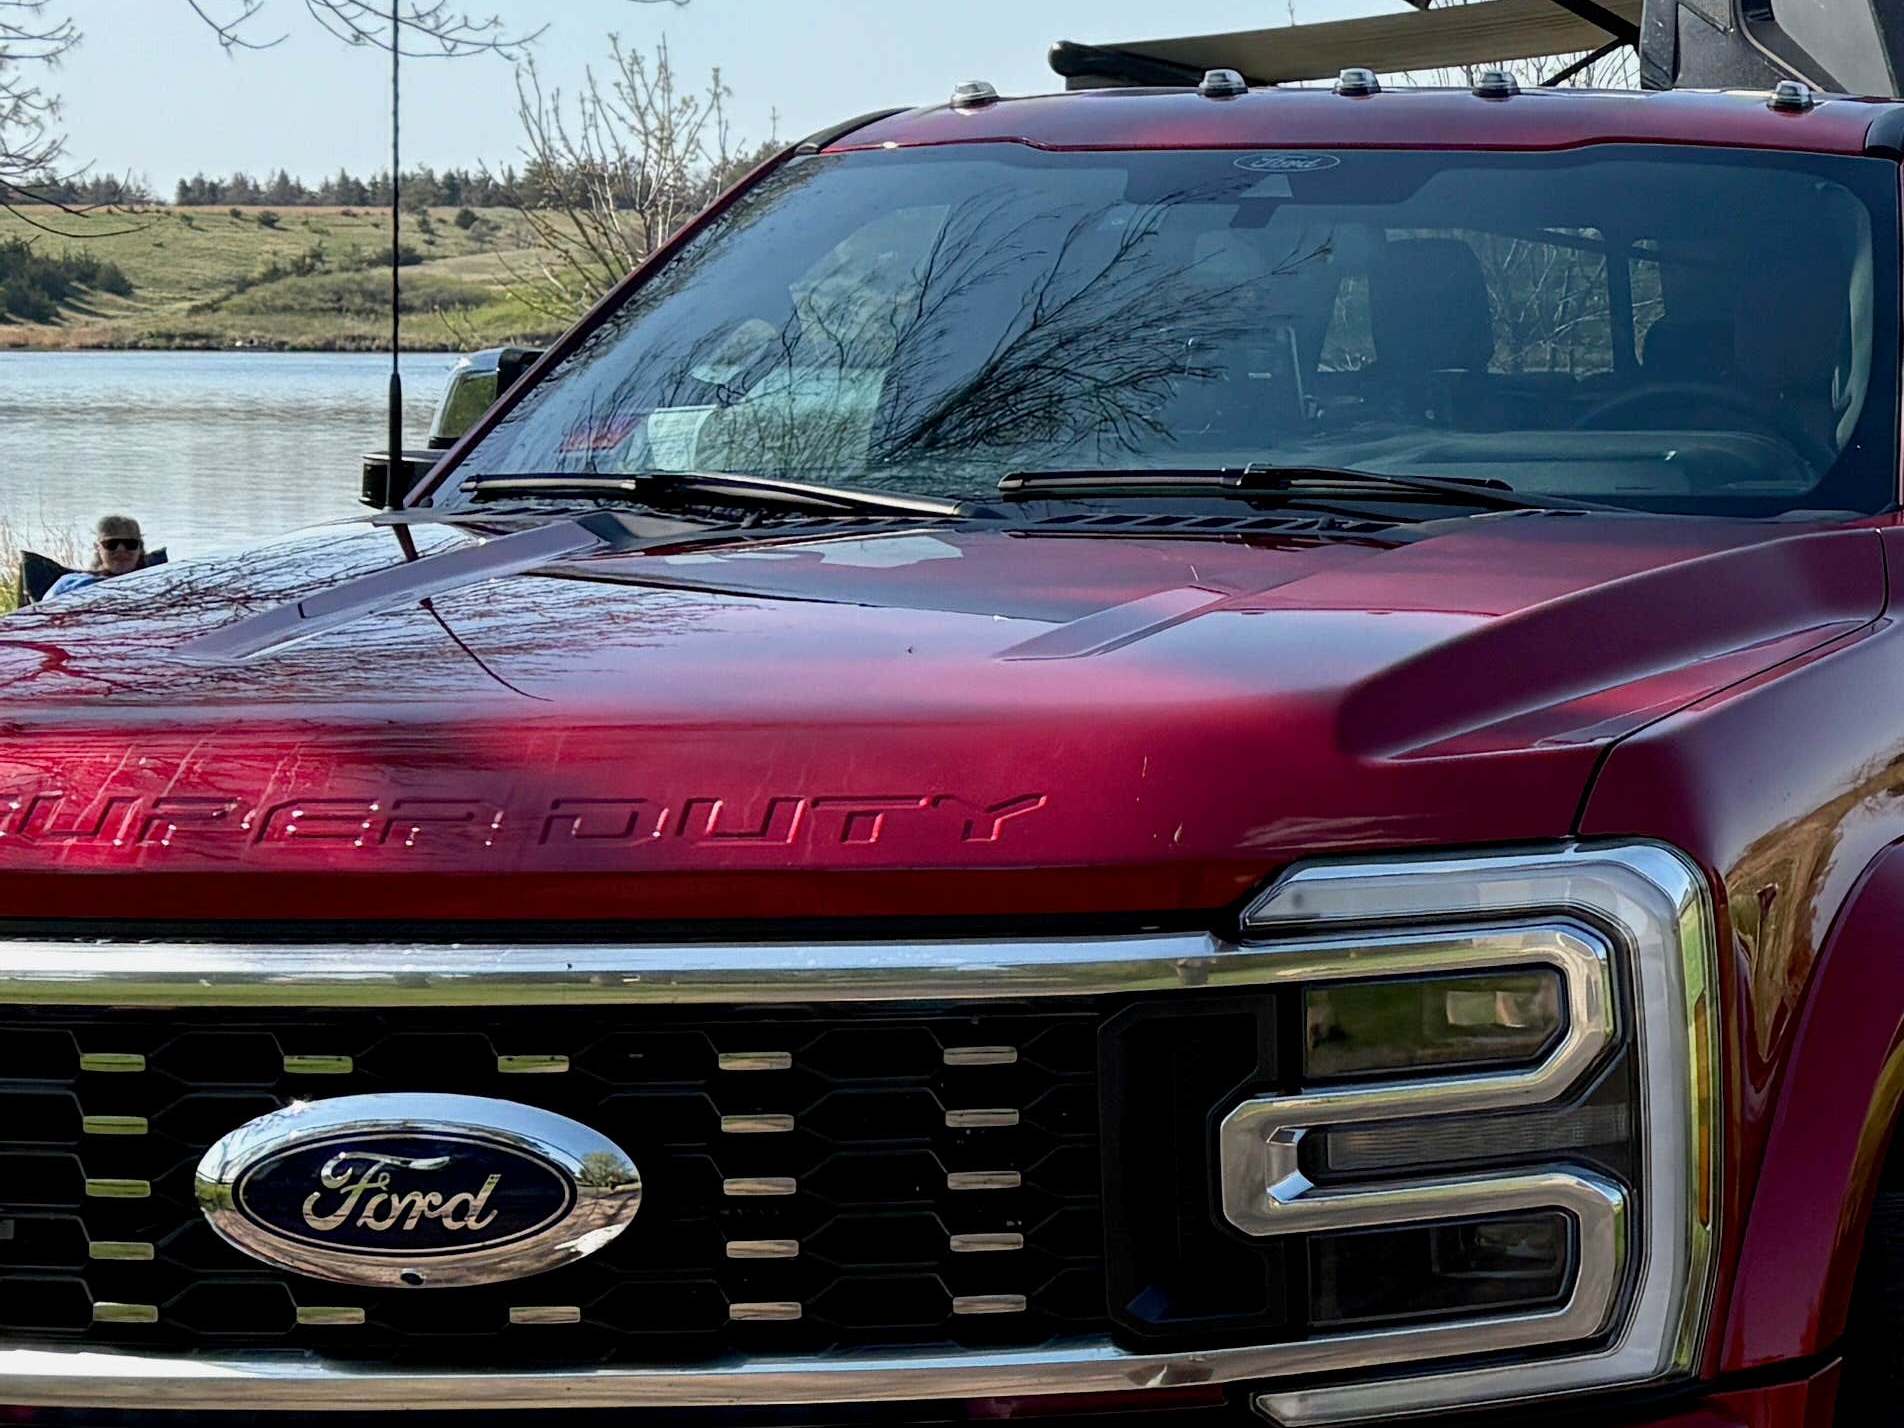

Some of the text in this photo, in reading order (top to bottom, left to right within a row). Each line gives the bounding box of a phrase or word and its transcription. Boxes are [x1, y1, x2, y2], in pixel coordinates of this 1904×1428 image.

[0, 792, 1048, 846] UPER DUTY
[302, 1150, 502, 1232] Ford
